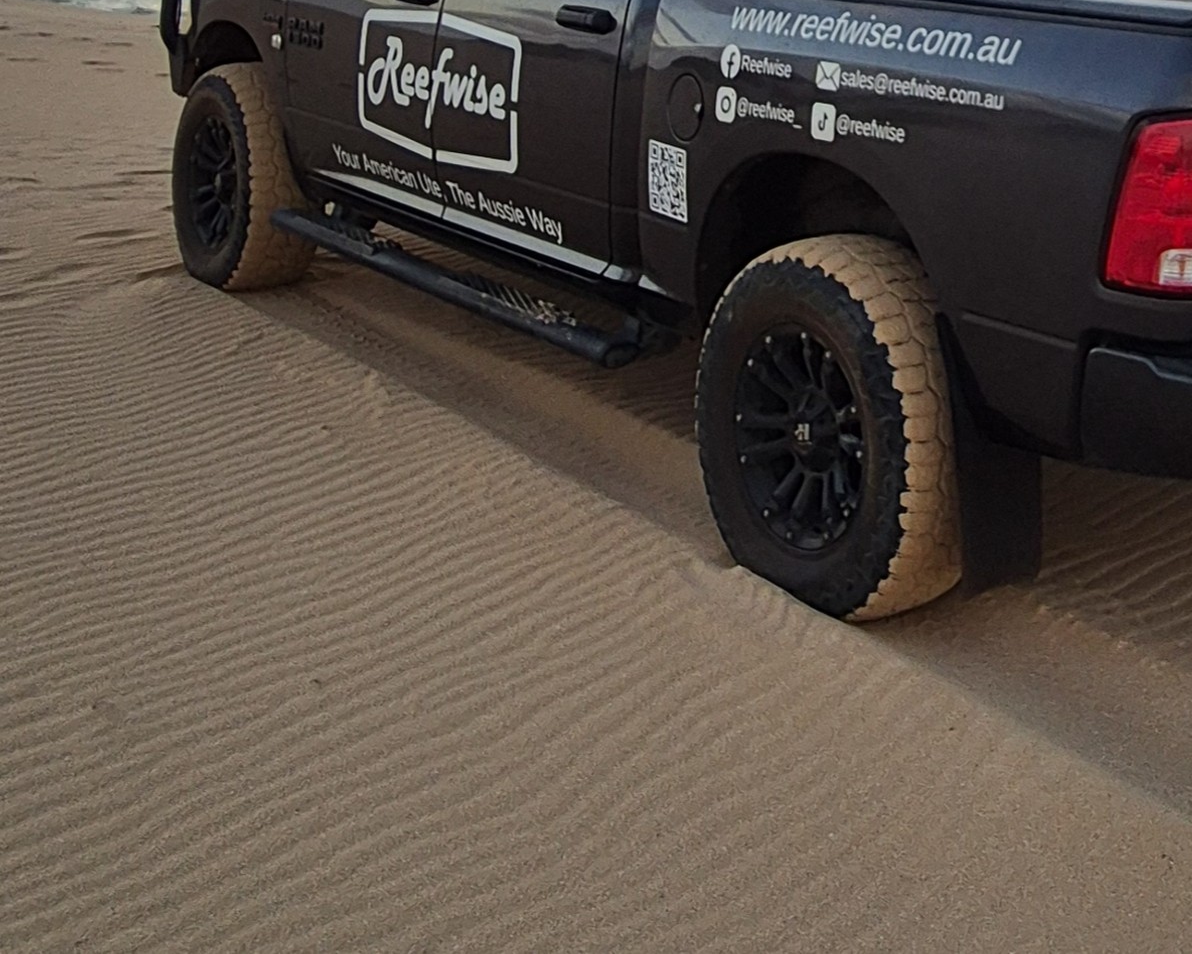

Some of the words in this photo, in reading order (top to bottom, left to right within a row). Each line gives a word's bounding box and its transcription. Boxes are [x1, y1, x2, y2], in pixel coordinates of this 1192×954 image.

[731, 5, 1022, 65] www.reefwise.com.au
[367, 35, 506, 129] Reefwise
[741, 54, 793, 78] Reefwise
[841, 71, 1004, 111] sales@reefwise.com.au
[836, 114, 906, 143] @reefwise
[332, 143, 361, 169] Your
[363, 154, 416, 187] American
[447, 180, 475, 209] The
[478, 191, 526, 225] Aussie
[526, 205, 563, 244] Way
